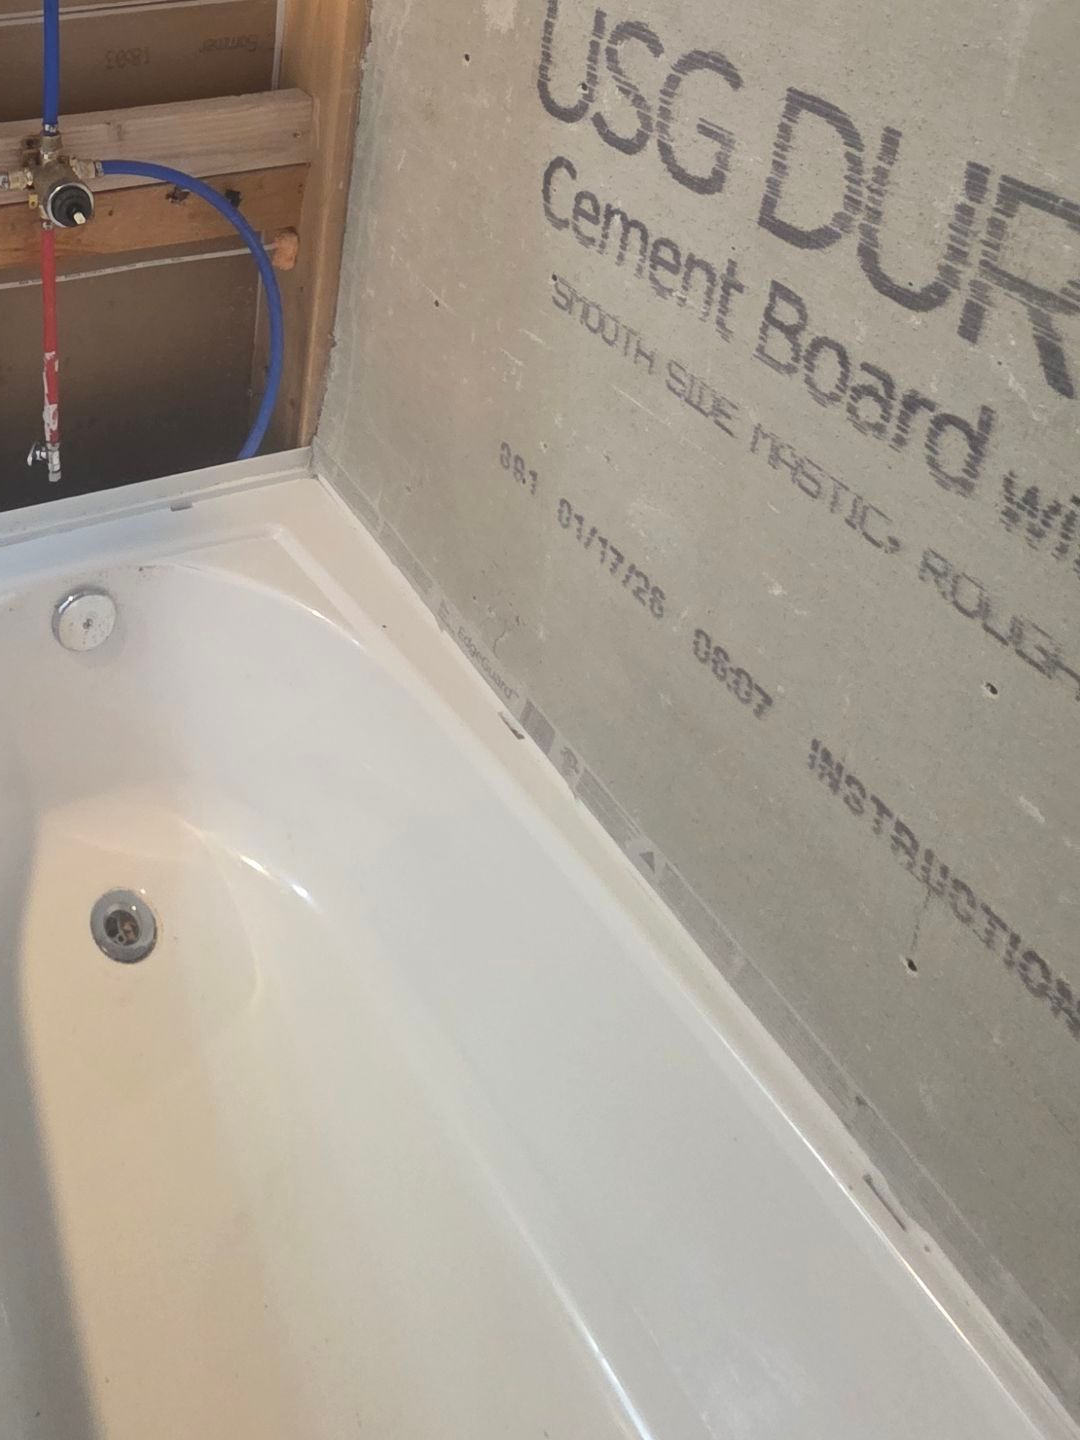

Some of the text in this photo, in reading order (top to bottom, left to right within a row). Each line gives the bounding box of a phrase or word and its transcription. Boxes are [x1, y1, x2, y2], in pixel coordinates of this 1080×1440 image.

[542, 156, 747, 343] Cement
[754, 280, 995, 498] Board
[552, 276, 657, 376] SMOOTH
[665, 359, 740, 438] SIDE
